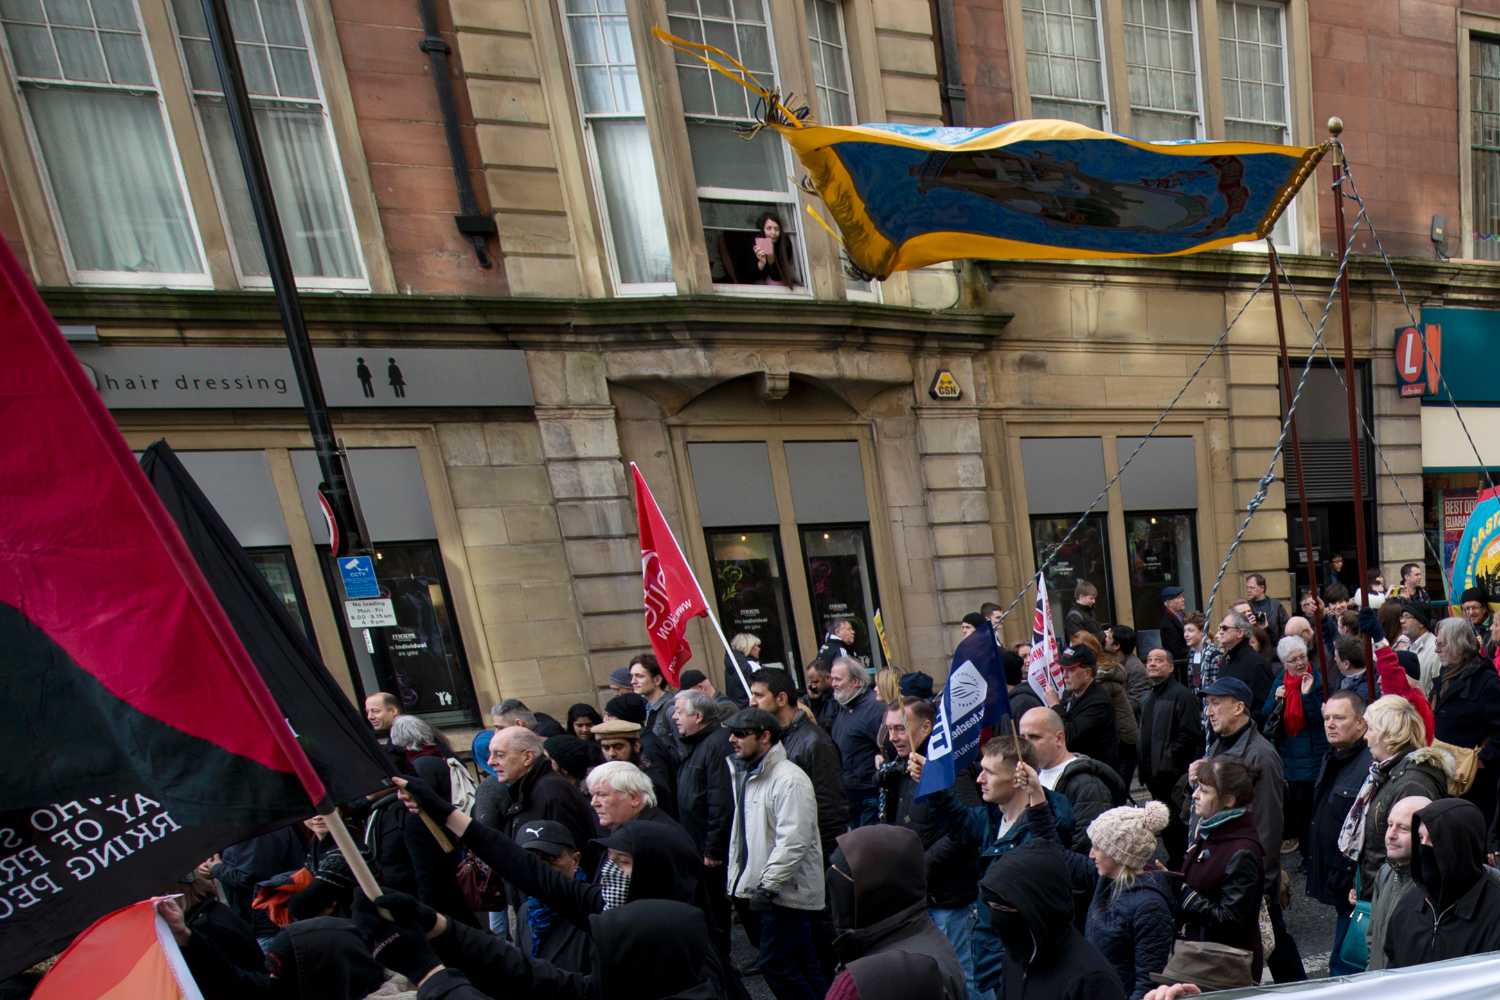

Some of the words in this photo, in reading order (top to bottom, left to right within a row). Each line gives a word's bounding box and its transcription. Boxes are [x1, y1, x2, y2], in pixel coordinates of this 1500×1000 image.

[1404, 333, 1418, 374] L
[104, 374, 159, 391] hair
[174, 374, 288, 394] dressing
[1444, 499, 1463, 515] BEST
